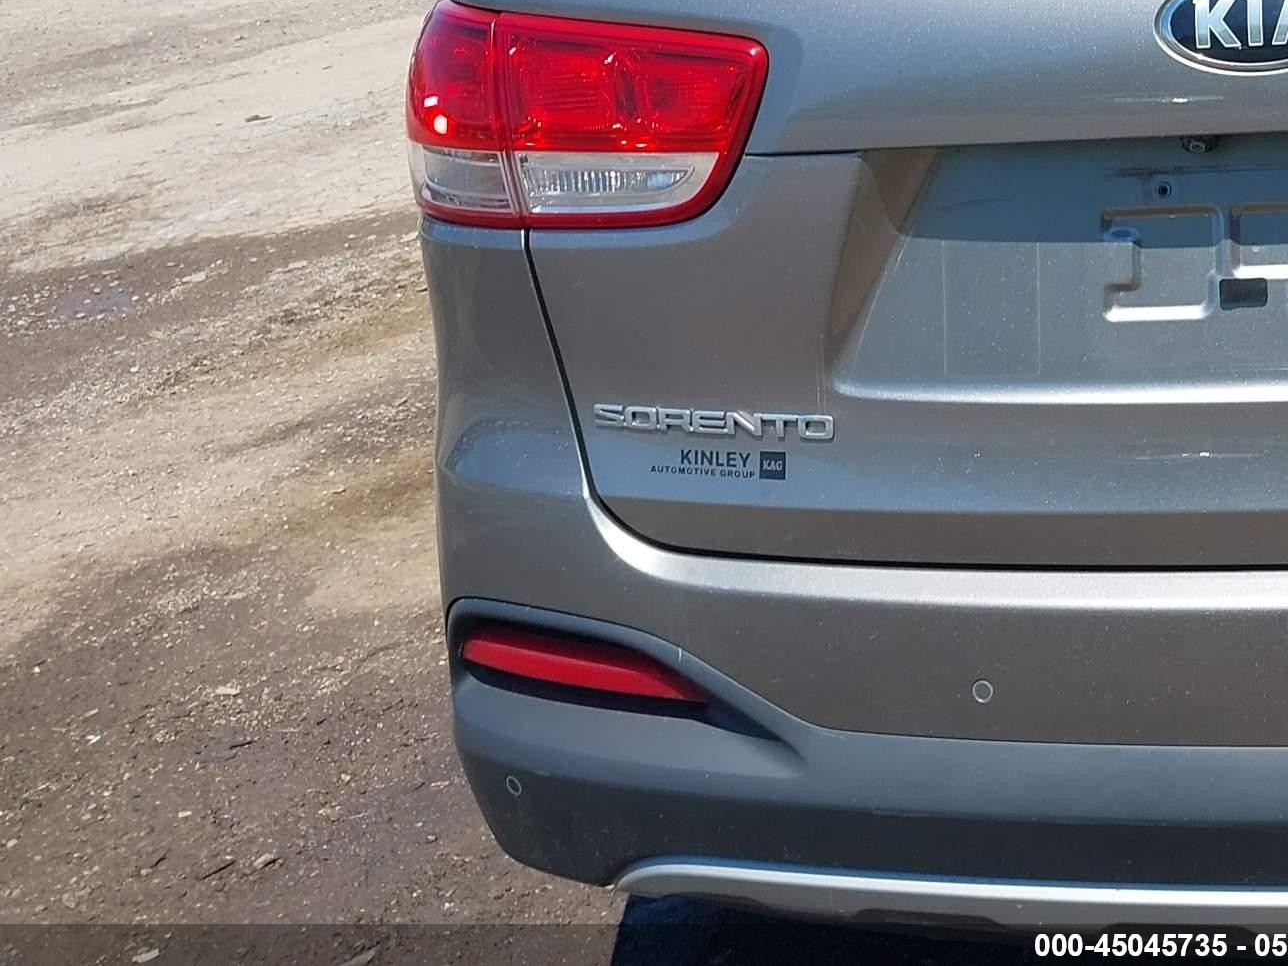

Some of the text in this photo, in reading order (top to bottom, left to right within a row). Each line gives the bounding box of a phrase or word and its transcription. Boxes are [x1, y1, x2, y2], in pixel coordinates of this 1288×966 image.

[593, 403, 835, 441] SORENTO
[680, 449, 752, 468] KINLEY
[651, 465, 756, 479] AUTOMOTIVE GROUP
